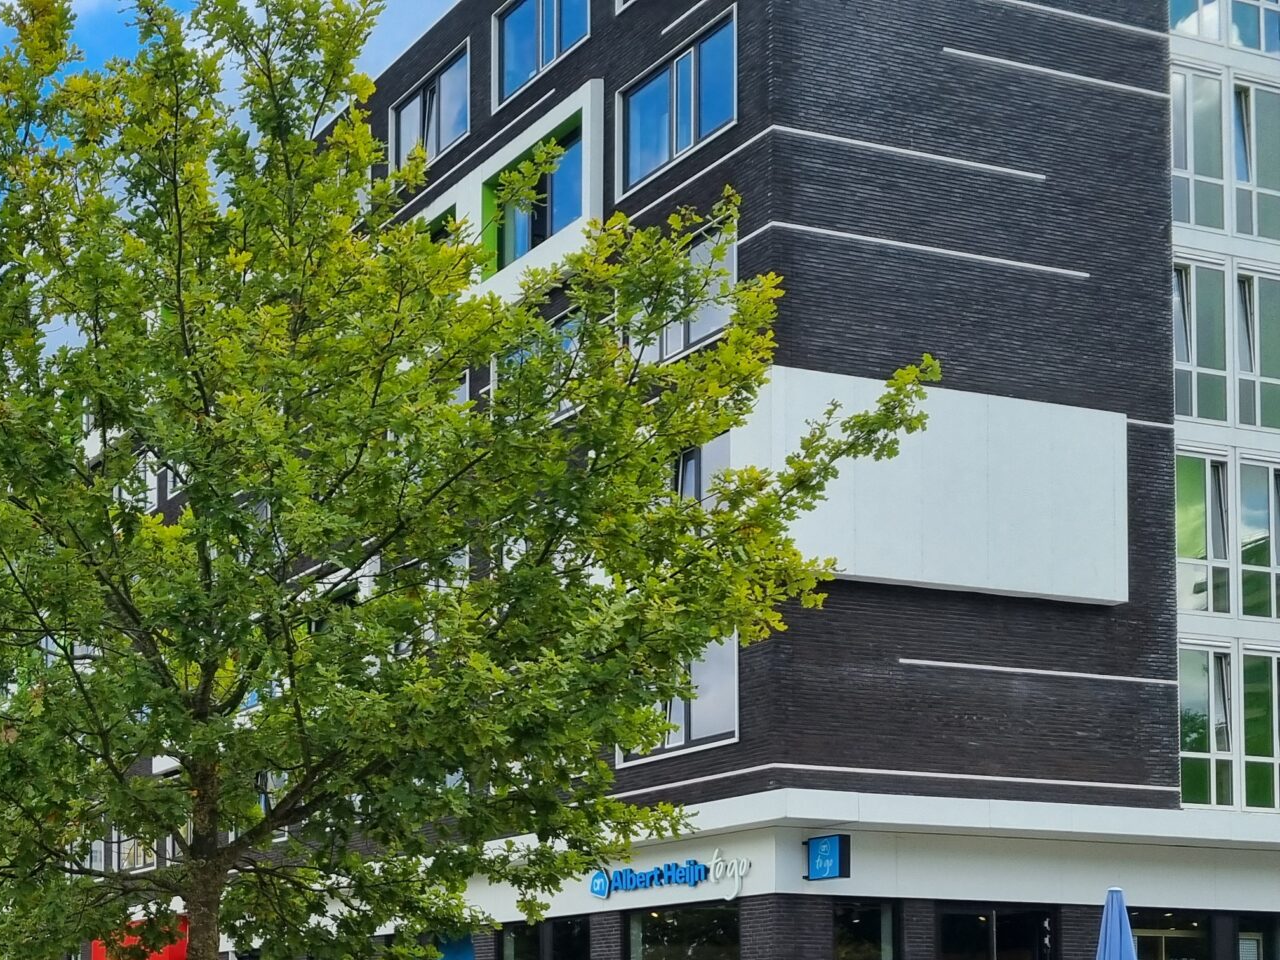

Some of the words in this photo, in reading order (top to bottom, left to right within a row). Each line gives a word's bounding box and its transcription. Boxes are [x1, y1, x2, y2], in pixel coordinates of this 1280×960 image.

[610, 867, 663, 892] Albert
[664, 860, 708, 887] Heijn
[705, 848, 724, 883] to
[726, 857, 751, 900] go
